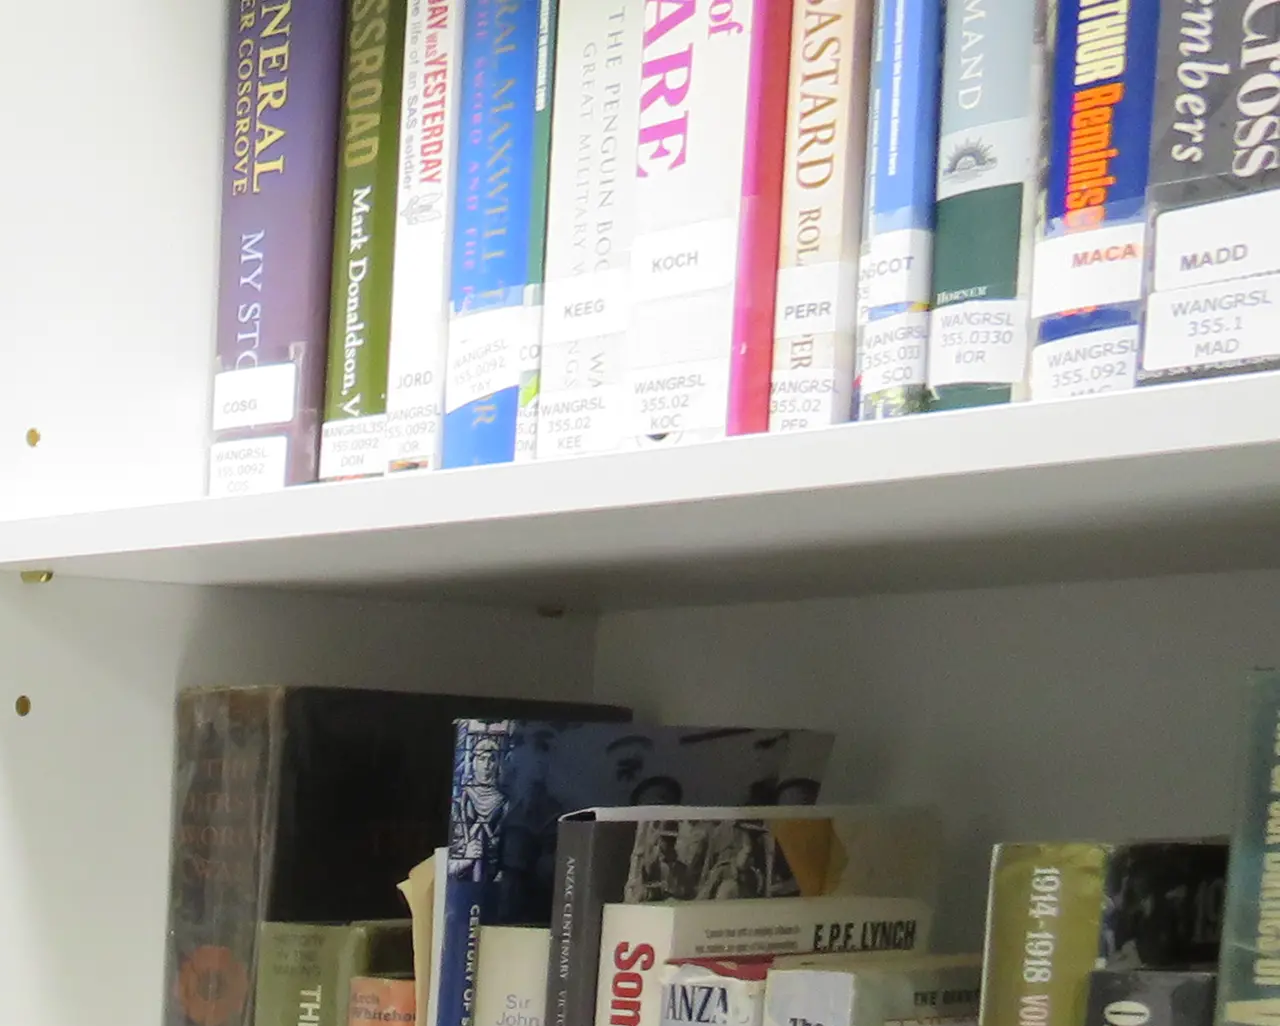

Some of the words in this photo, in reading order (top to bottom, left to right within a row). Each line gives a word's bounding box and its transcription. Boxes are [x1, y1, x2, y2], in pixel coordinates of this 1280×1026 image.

[409, 21, 420, 46] life
[604, 6, 626, 69] THE
[408, 50, 419, 67] of
[252, 0, 291, 193] NERAL
[407, 72, 417, 91] an
[232, 38, 255, 196] COSGROVE
[404, 95, 419, 130] SAS
[419, 53, 449, 185] YESTERDAY
[402, 133, 416, 191] soldier
[597, 82, 622, 209] PENGUIN
[351, 185, 373, 253] Mark
[239, 230, 265, 292] MY
[651, 251, 699, 273] KOCH
[1072, 243, 1139, 268] MACA
[1179, 243, 1249, 272] MADD
[340, 256, 370, 396] Donaldson,
[784, 301, 832, 321] PERR
[563, 856, 576, 900] ANZAC
[559, 903, 575, 981] CENTENARY
[812, 922, 858, 952] E.P.F.
[860, 919, 917, 951] LYNCH
[1022, 866, 1062, 984] 1914-1918
[462, 988, 477, 1011] OF
[505, 994, 532, 1010] Sir
